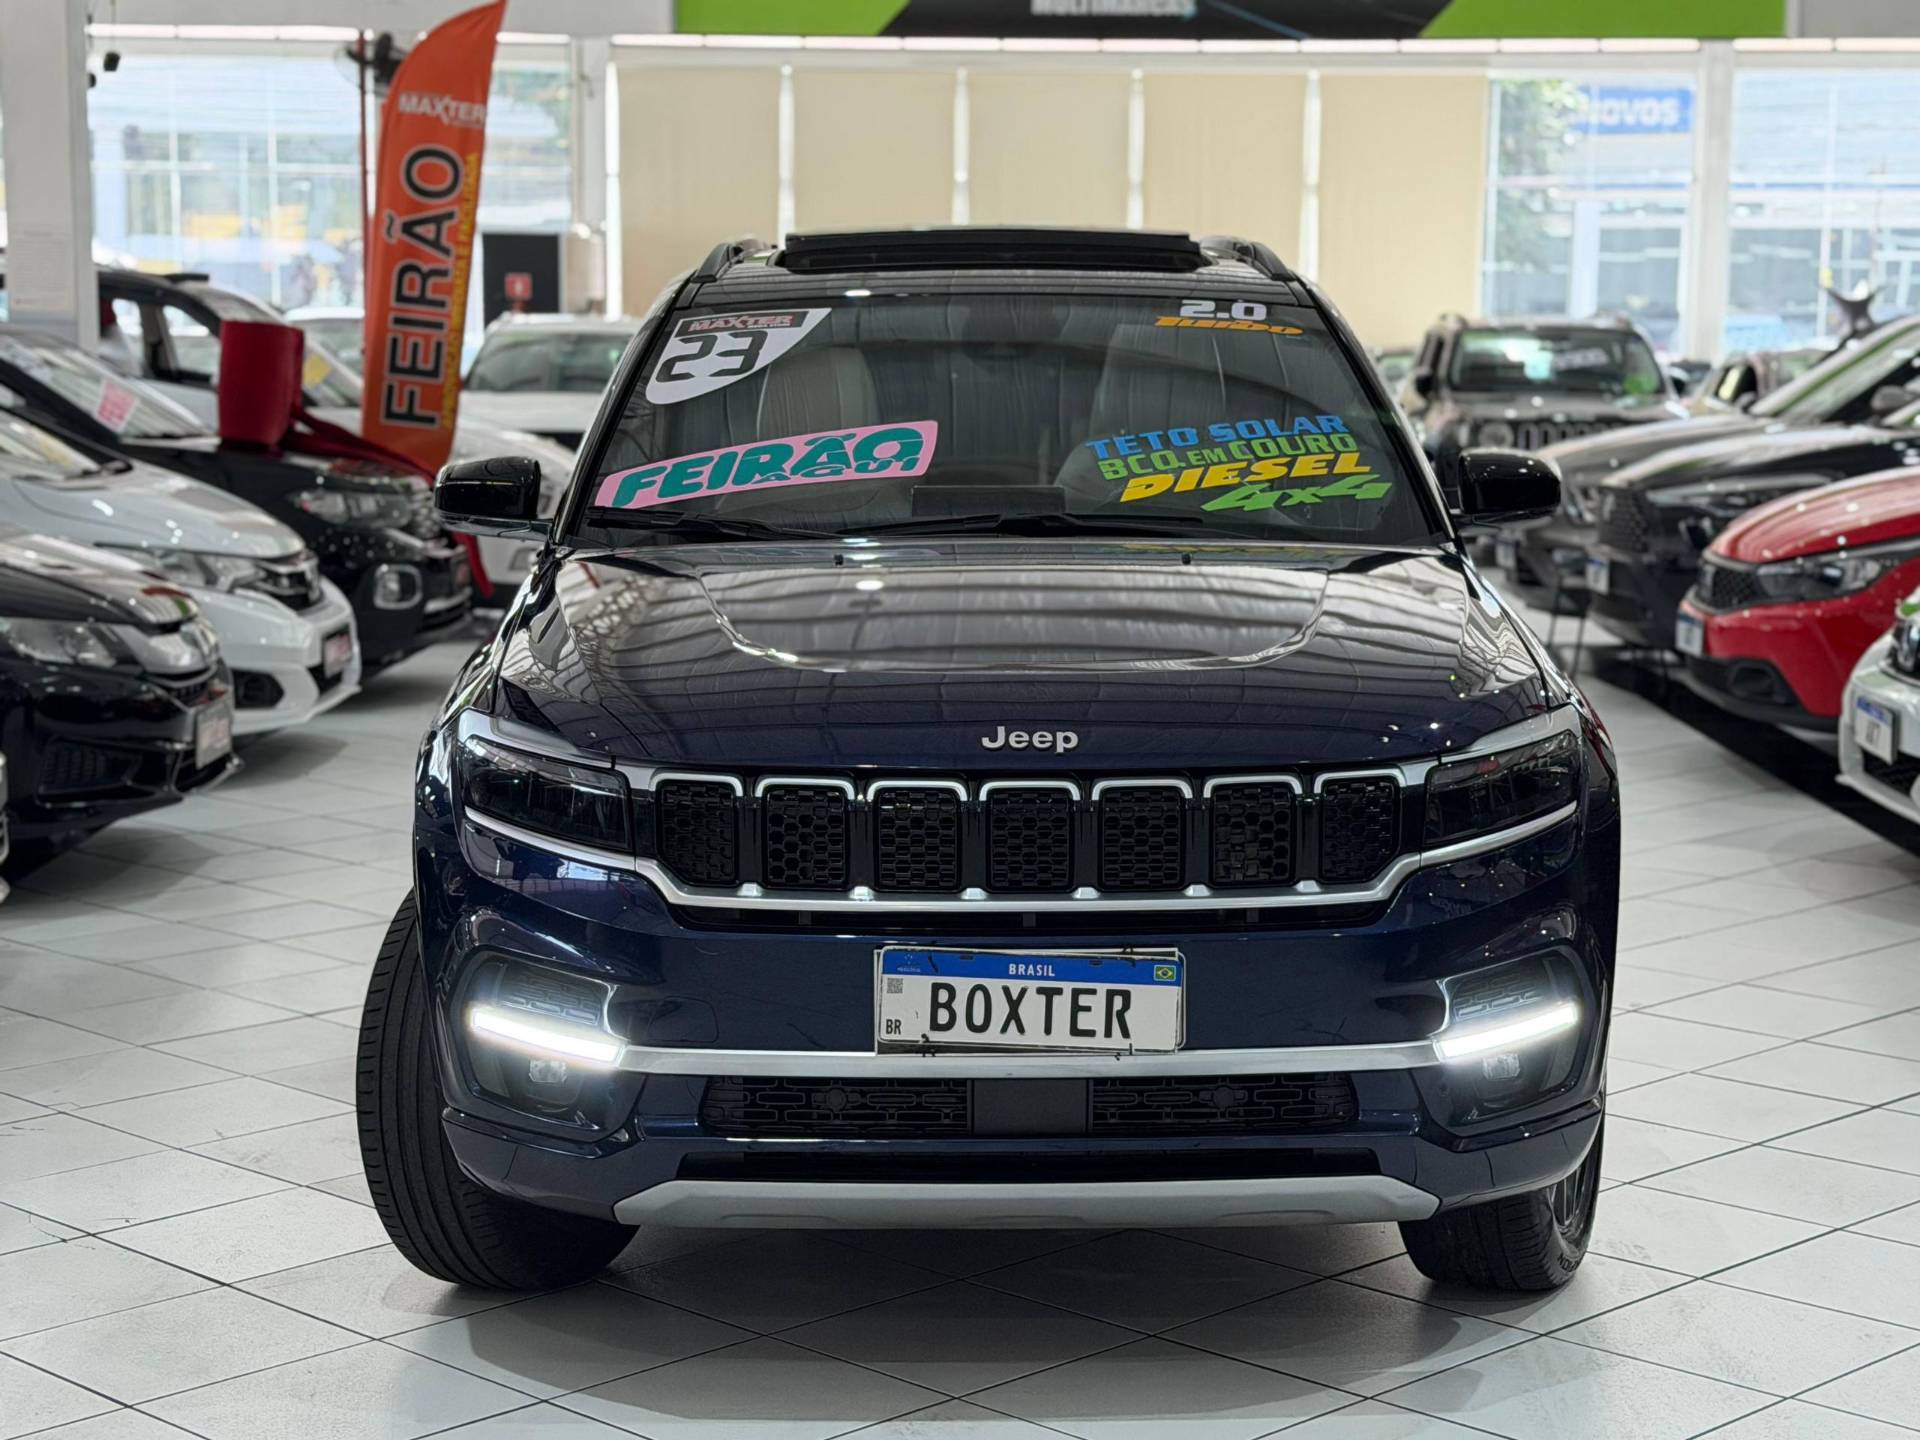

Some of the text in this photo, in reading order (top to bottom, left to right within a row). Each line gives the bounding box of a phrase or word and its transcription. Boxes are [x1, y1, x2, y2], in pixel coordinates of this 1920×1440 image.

[398, 92, 486, 125] MAXTER
[382, 144, 464, 429] FEIRÃO
[688, 315, 795, 331] MAXTER
[1180, 300, 1267, 320] 2.0
[655, 330, 769, 383] 23
[1086, 415, 1350, 459] TETO SOLAR
[1187, 447, 1231, 466] EM
[1229, 433, 1359, 460] COURO
[611, 427, 924, 507] FEIRÃO
[1120, 452, 1372, 502] DIESEL
[981, 726, 1079, 753] Jeep
[1008, 963, 1056, 977] BRASIL
[885, 1019, 902, 1035] BR
[929, 982, 1132, 1039] BOXTER
